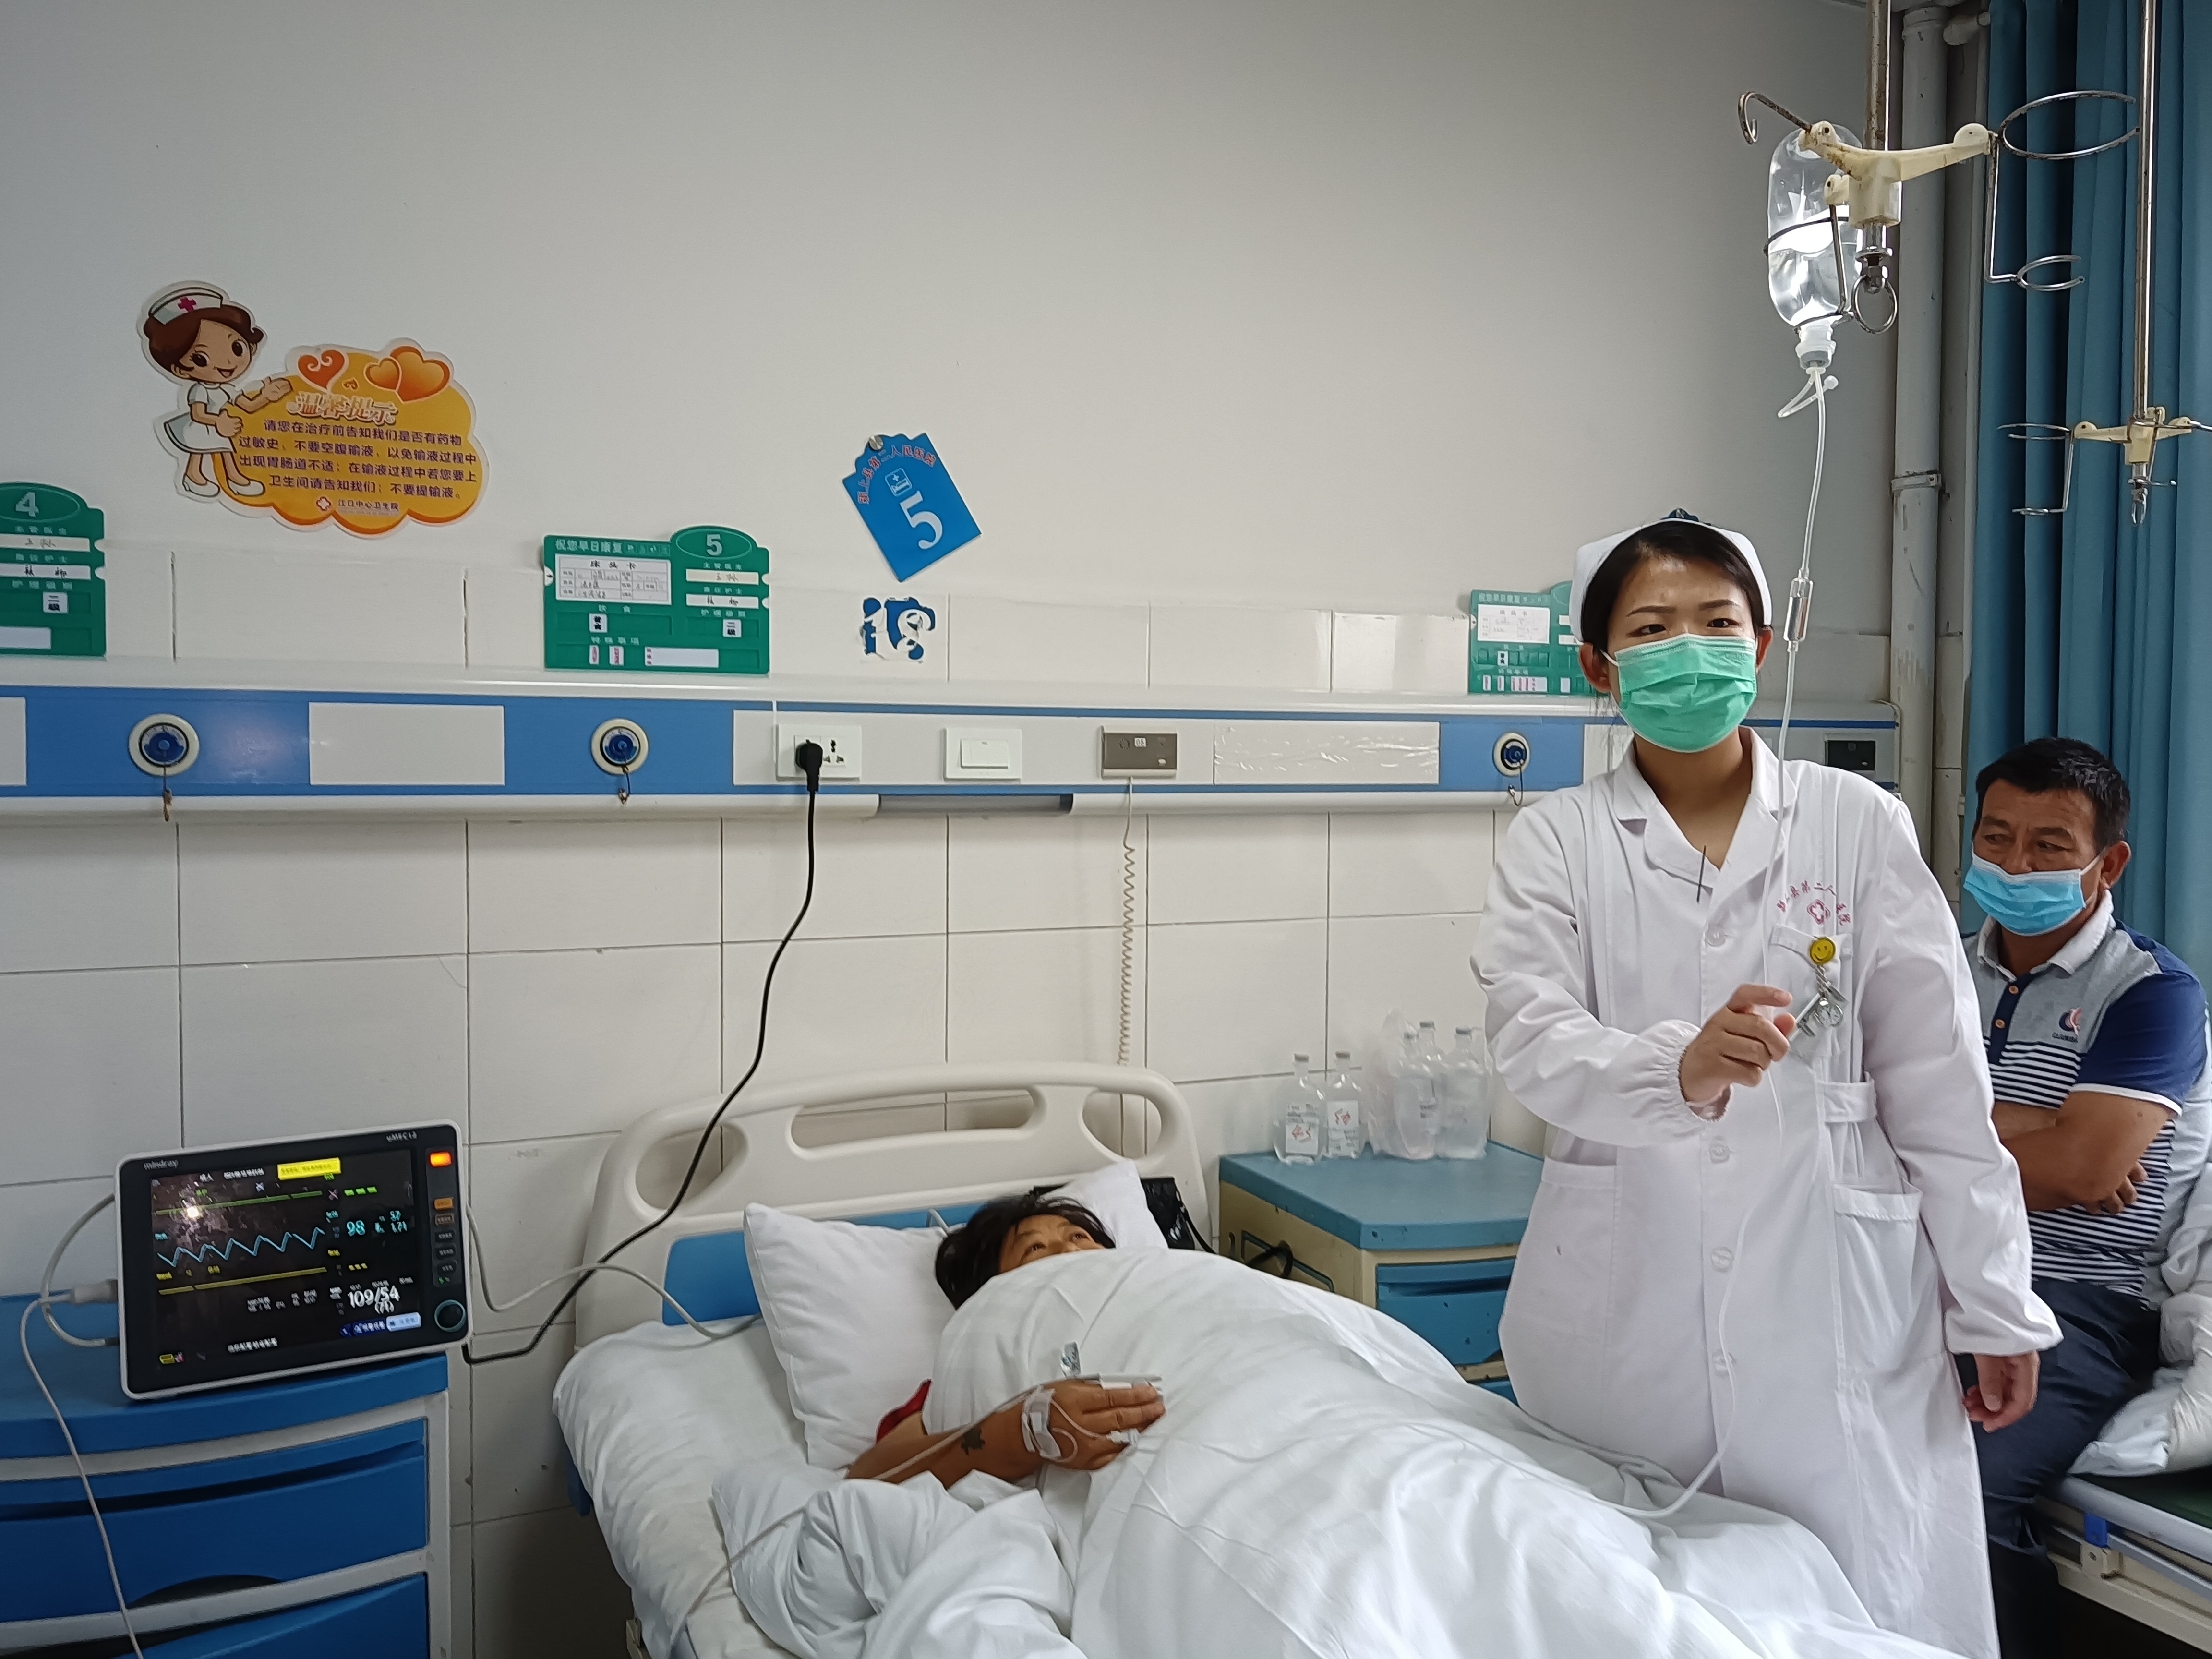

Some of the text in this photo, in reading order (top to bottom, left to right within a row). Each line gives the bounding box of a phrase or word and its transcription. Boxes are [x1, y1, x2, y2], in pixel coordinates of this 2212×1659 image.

[264, 419, 462, 446] 请您在治疗前告知我们是否有药物
[15, 492, 40, 517] 4
[338, 499, 399, 510] 江口中心卫生院
[900, 490, 943, 550] 5
[706, 534, 723, 556] 5
[346, 1220, 366, 1237] 98
[347, 1285, 400, 1309] 109/54
